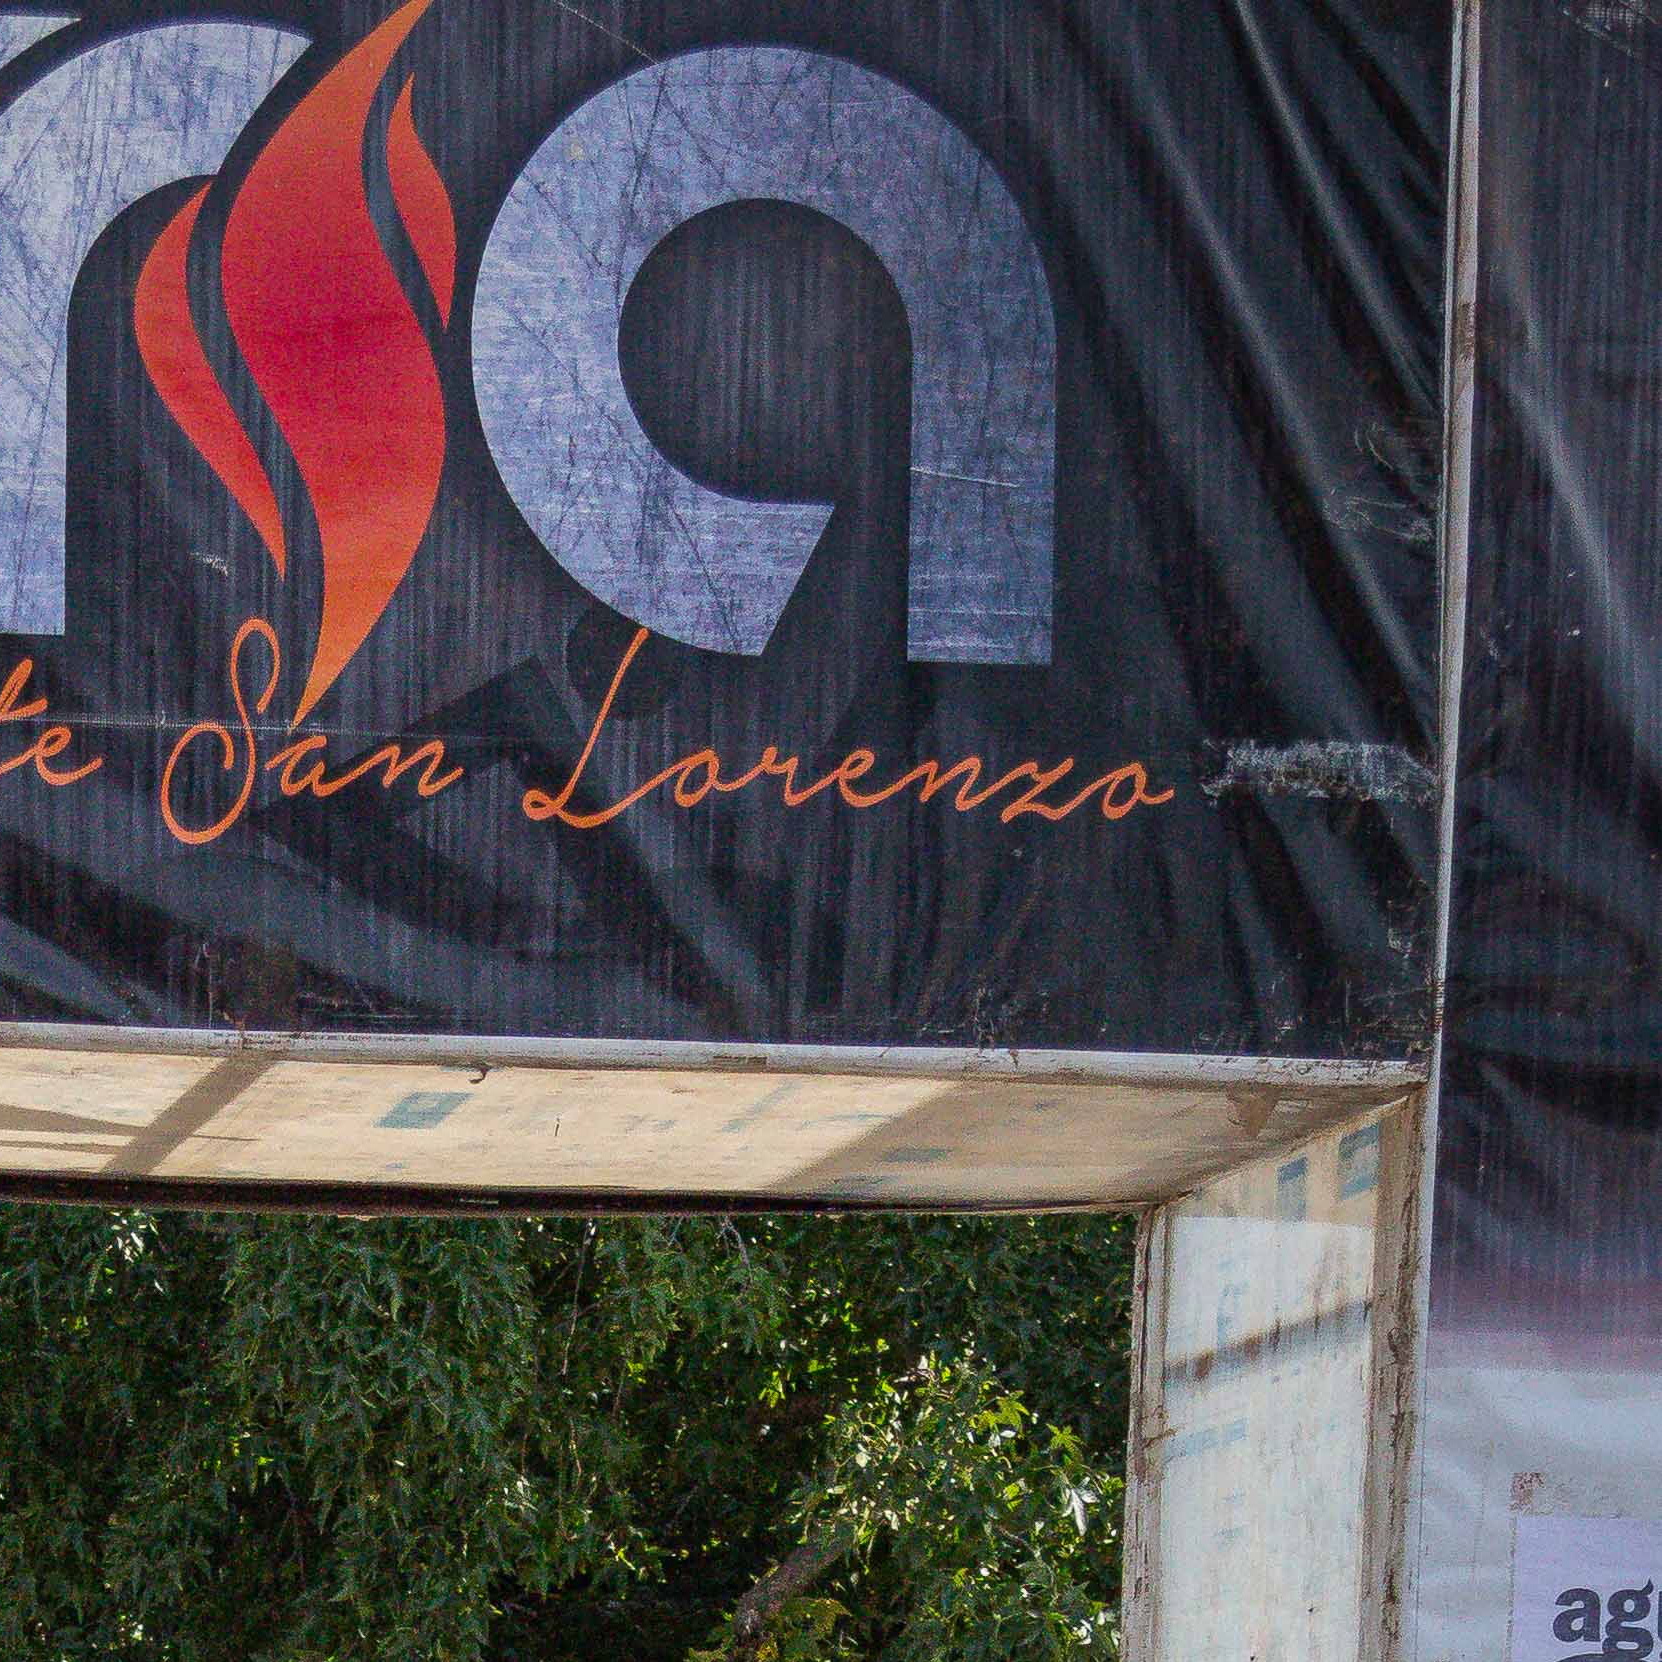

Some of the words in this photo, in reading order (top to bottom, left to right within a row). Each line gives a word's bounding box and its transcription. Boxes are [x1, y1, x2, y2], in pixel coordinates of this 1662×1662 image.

[160, 617, 464, 844] San
[522, 625, 1176, 828] Lorenzo
[1553, 1577, 1662, 1660] ag
